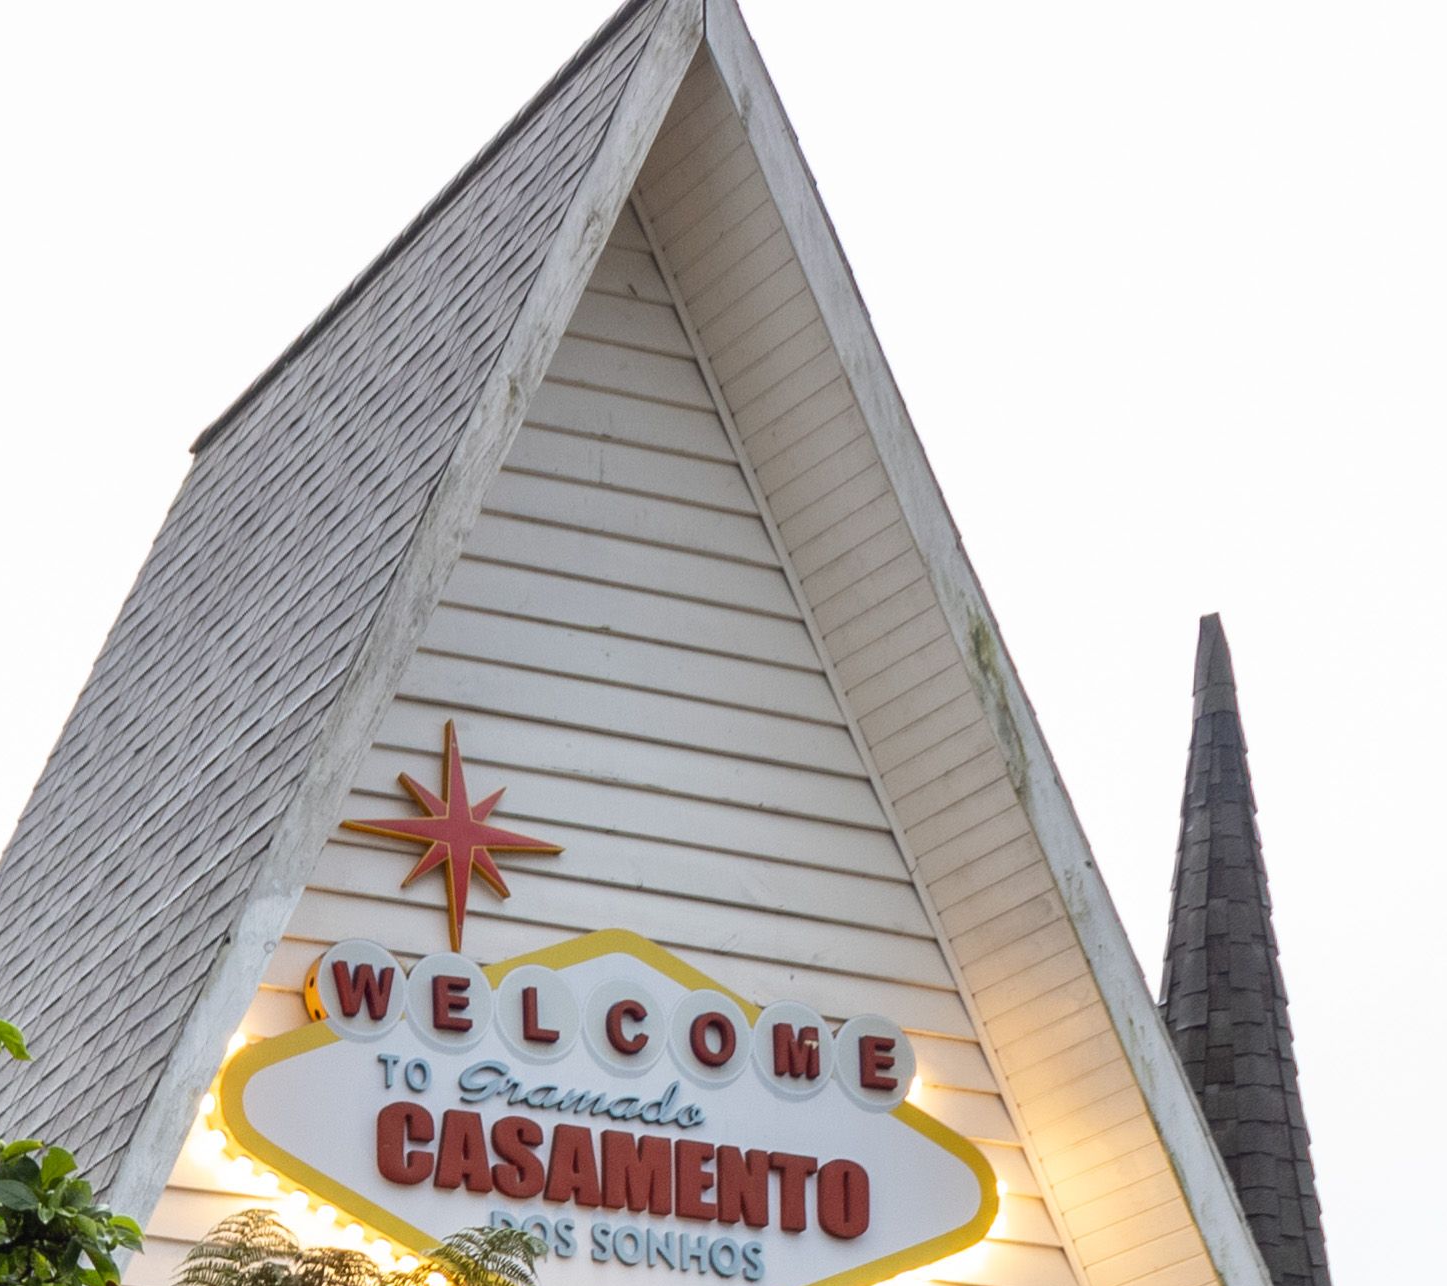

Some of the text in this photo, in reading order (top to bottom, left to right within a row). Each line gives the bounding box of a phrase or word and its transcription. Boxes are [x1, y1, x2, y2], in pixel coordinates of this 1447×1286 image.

[332, 960, 897, 1091] WELCOME
[378, 1053, 705, 1129] TO Gramado
[376, 1101, 870, 1240] CASAMENTO
[591, 1221, 766, 1282] SONHOS
